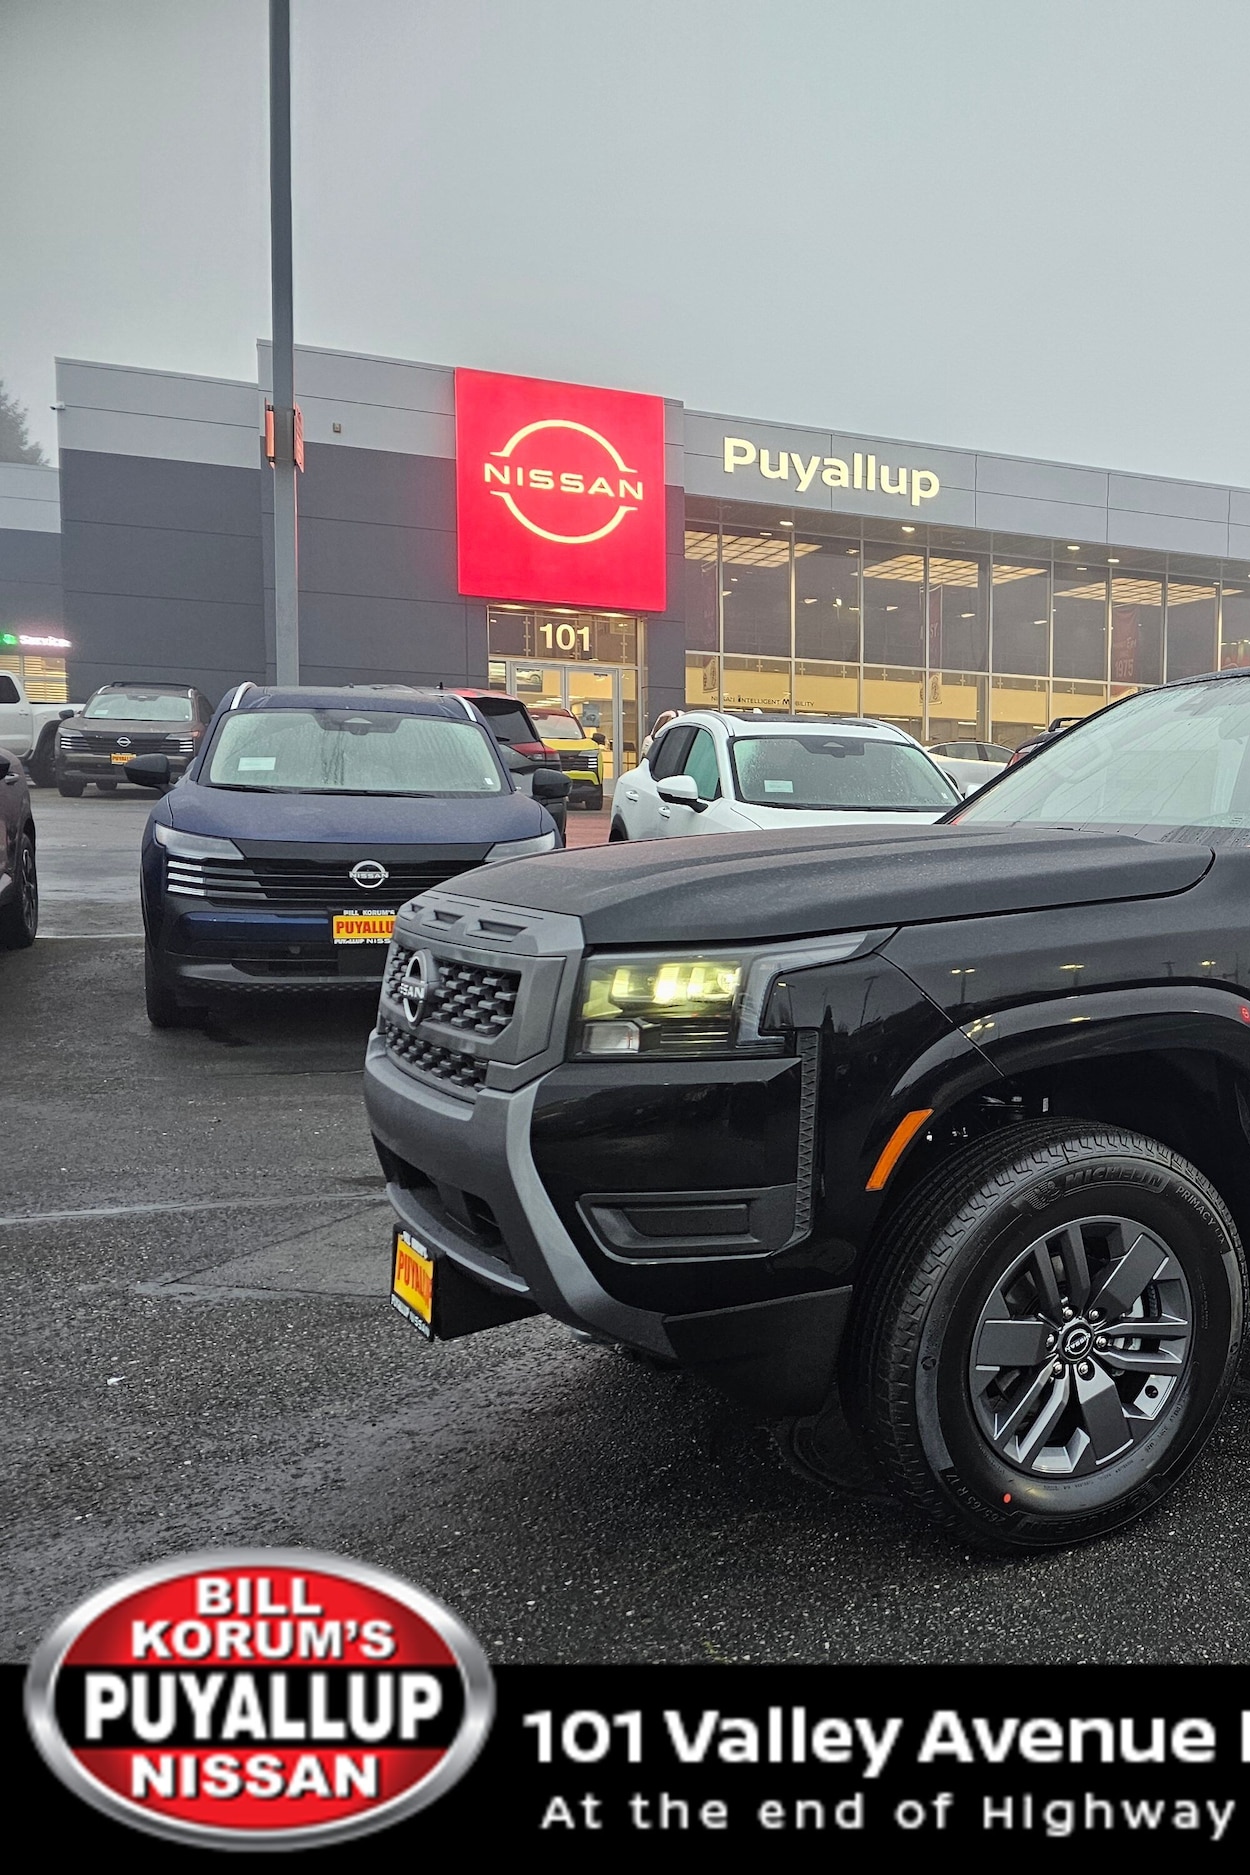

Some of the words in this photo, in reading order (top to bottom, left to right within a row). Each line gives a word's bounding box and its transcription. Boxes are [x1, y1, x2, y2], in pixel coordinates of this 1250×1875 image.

[484, 462, 644, 500] NISSAN
[723, 436, 941, 506] Puyallup
[540, 623, 590, 651] 101
[336, 921, 396, 934] PUYALLU
[1063, 1167, 1164, 1188] MICHELIN
[1175, 1185, 1218, 1226] PRIMACY
